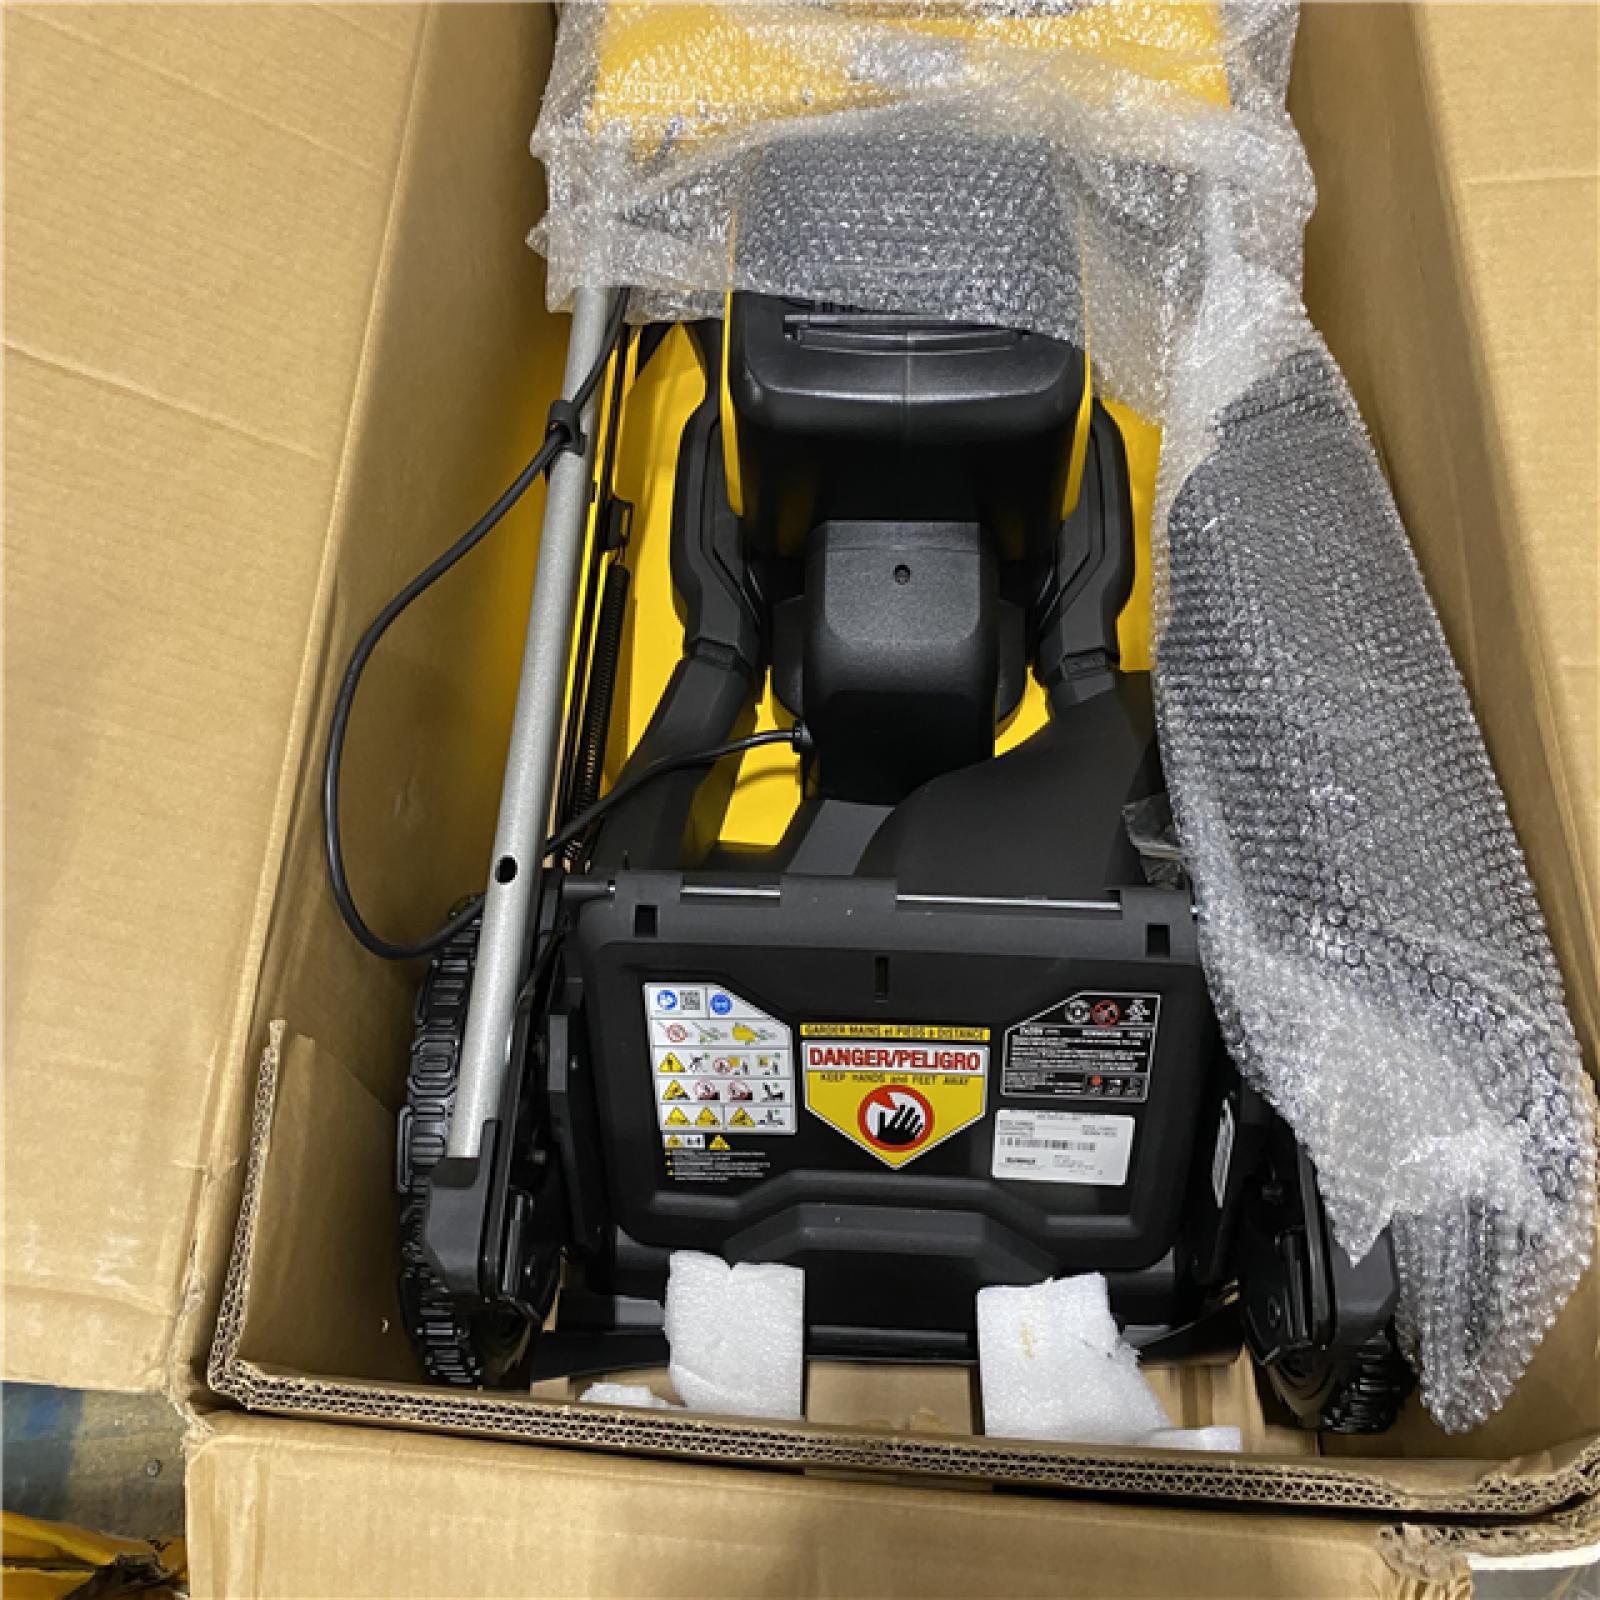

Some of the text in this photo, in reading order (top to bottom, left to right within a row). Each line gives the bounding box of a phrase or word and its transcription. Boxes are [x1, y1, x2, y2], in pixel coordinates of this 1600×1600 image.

[849, 1025, 880, 1037] MAINS
[809, 1047, 981, 1071] DANGER/PELIGRO
[820, 1072, 846, 1081] KEEP
[852, 1073, 885, 1083] HANDS
[912, 1075, 936, 1085] FEET
[943, 1075, 969, 1086] AWAY
